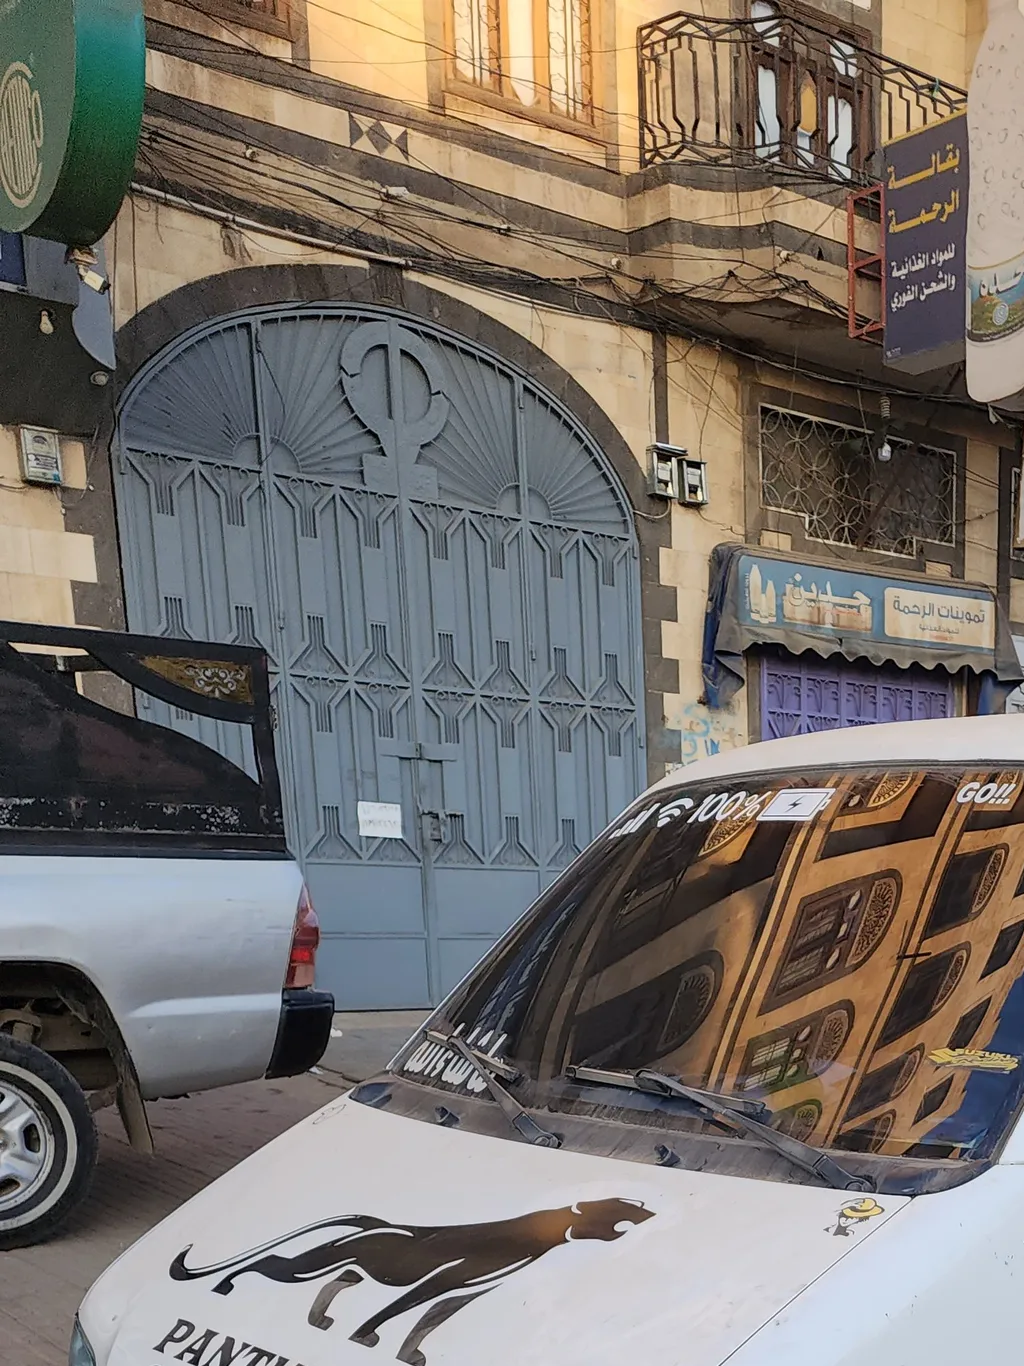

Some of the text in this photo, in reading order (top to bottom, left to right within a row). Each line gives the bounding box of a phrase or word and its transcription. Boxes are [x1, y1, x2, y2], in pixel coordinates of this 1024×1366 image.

[887, 143, 960, 190] بقالة
[888, 189, 960, 234] الرحمة
[891, 242, 956, 280] للمواد الغذائية
[890, 270, 956, 312] والشحن الفوري
[893, 595, 985, 625] تموينات الرحمة
[687, 790, 772, 824] 100%
[956, 781, 1016, 805] GO!!
